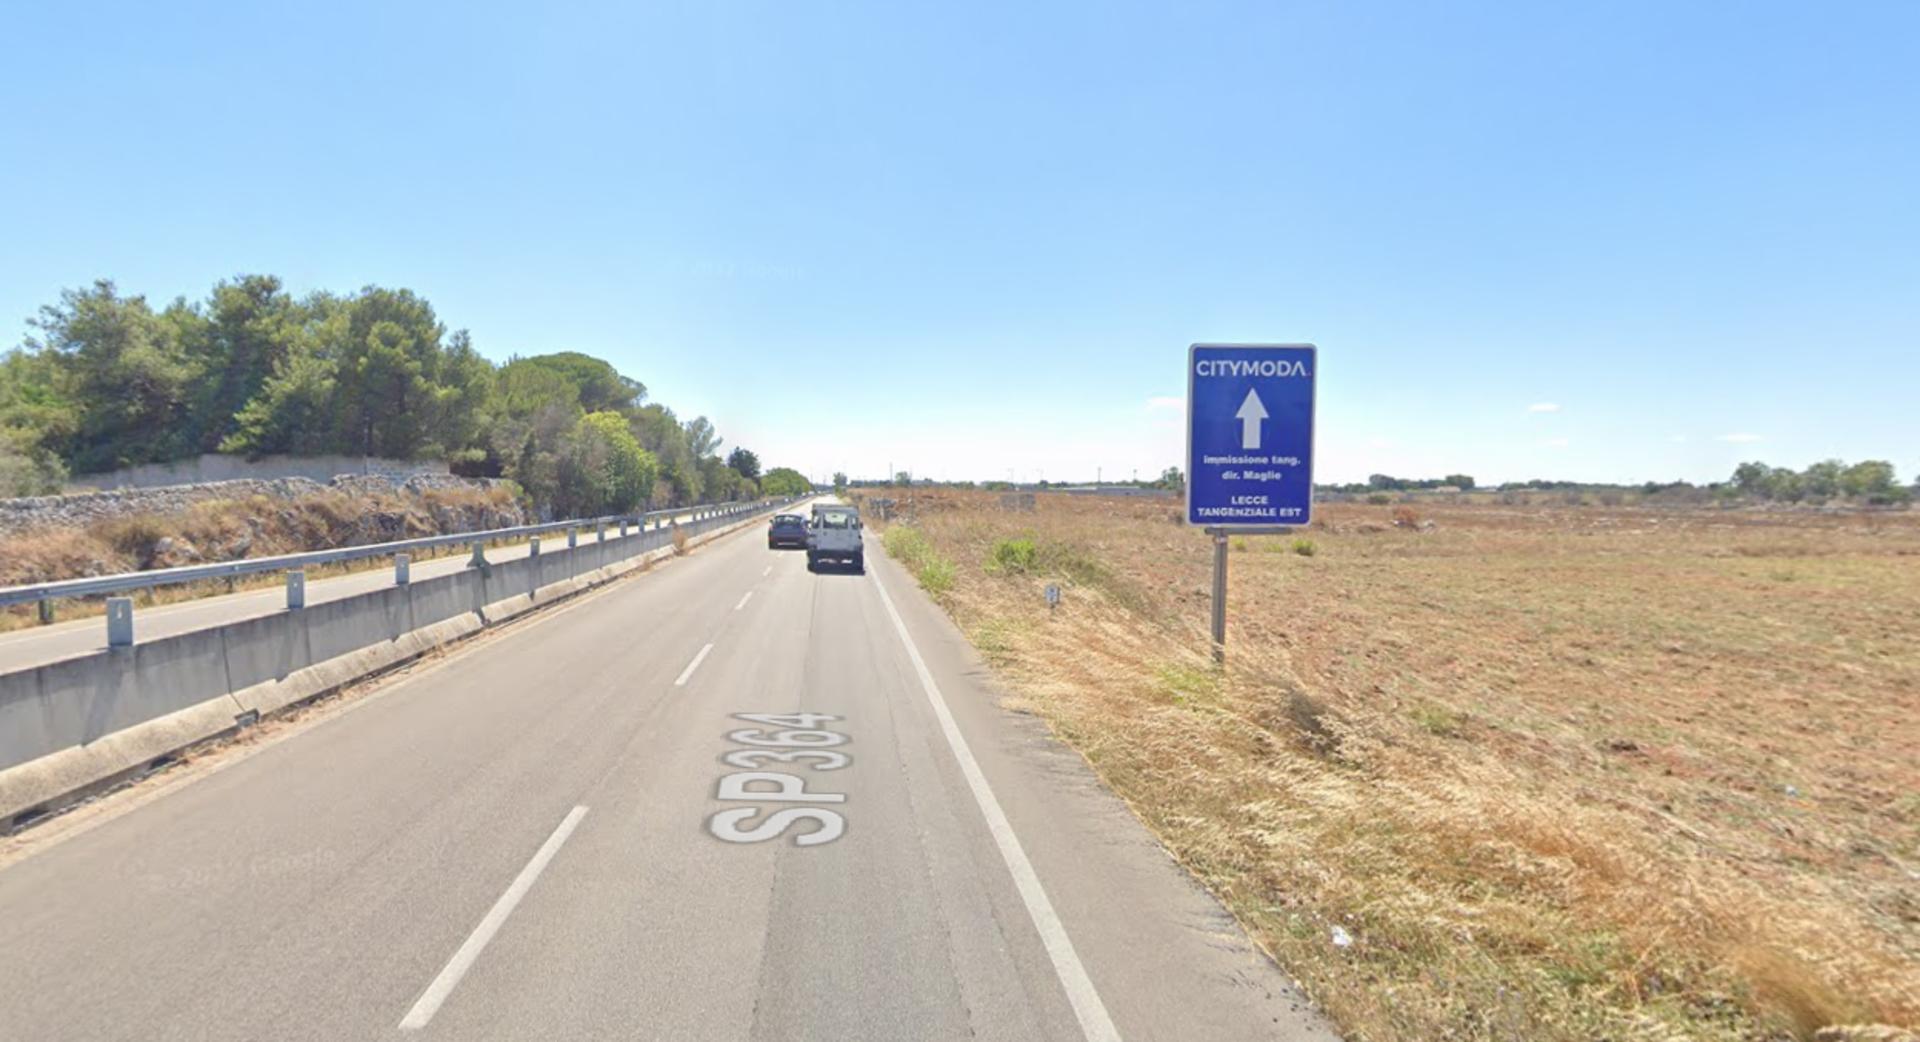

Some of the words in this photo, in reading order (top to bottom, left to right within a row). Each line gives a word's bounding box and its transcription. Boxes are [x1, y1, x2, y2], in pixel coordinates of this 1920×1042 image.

[1203, 455, 1269, 465] immissione
[1271, 455, 1301, 467] tang.
[1222, 470, 1241, 480] dir.
[1243, 470, 1282, 482] Maglie
[1231, 495, 1269, 505] LECCE
[1197, 507, 1277, 517] TANGENZIALE
[1279, 507, 1302, 517] EST
